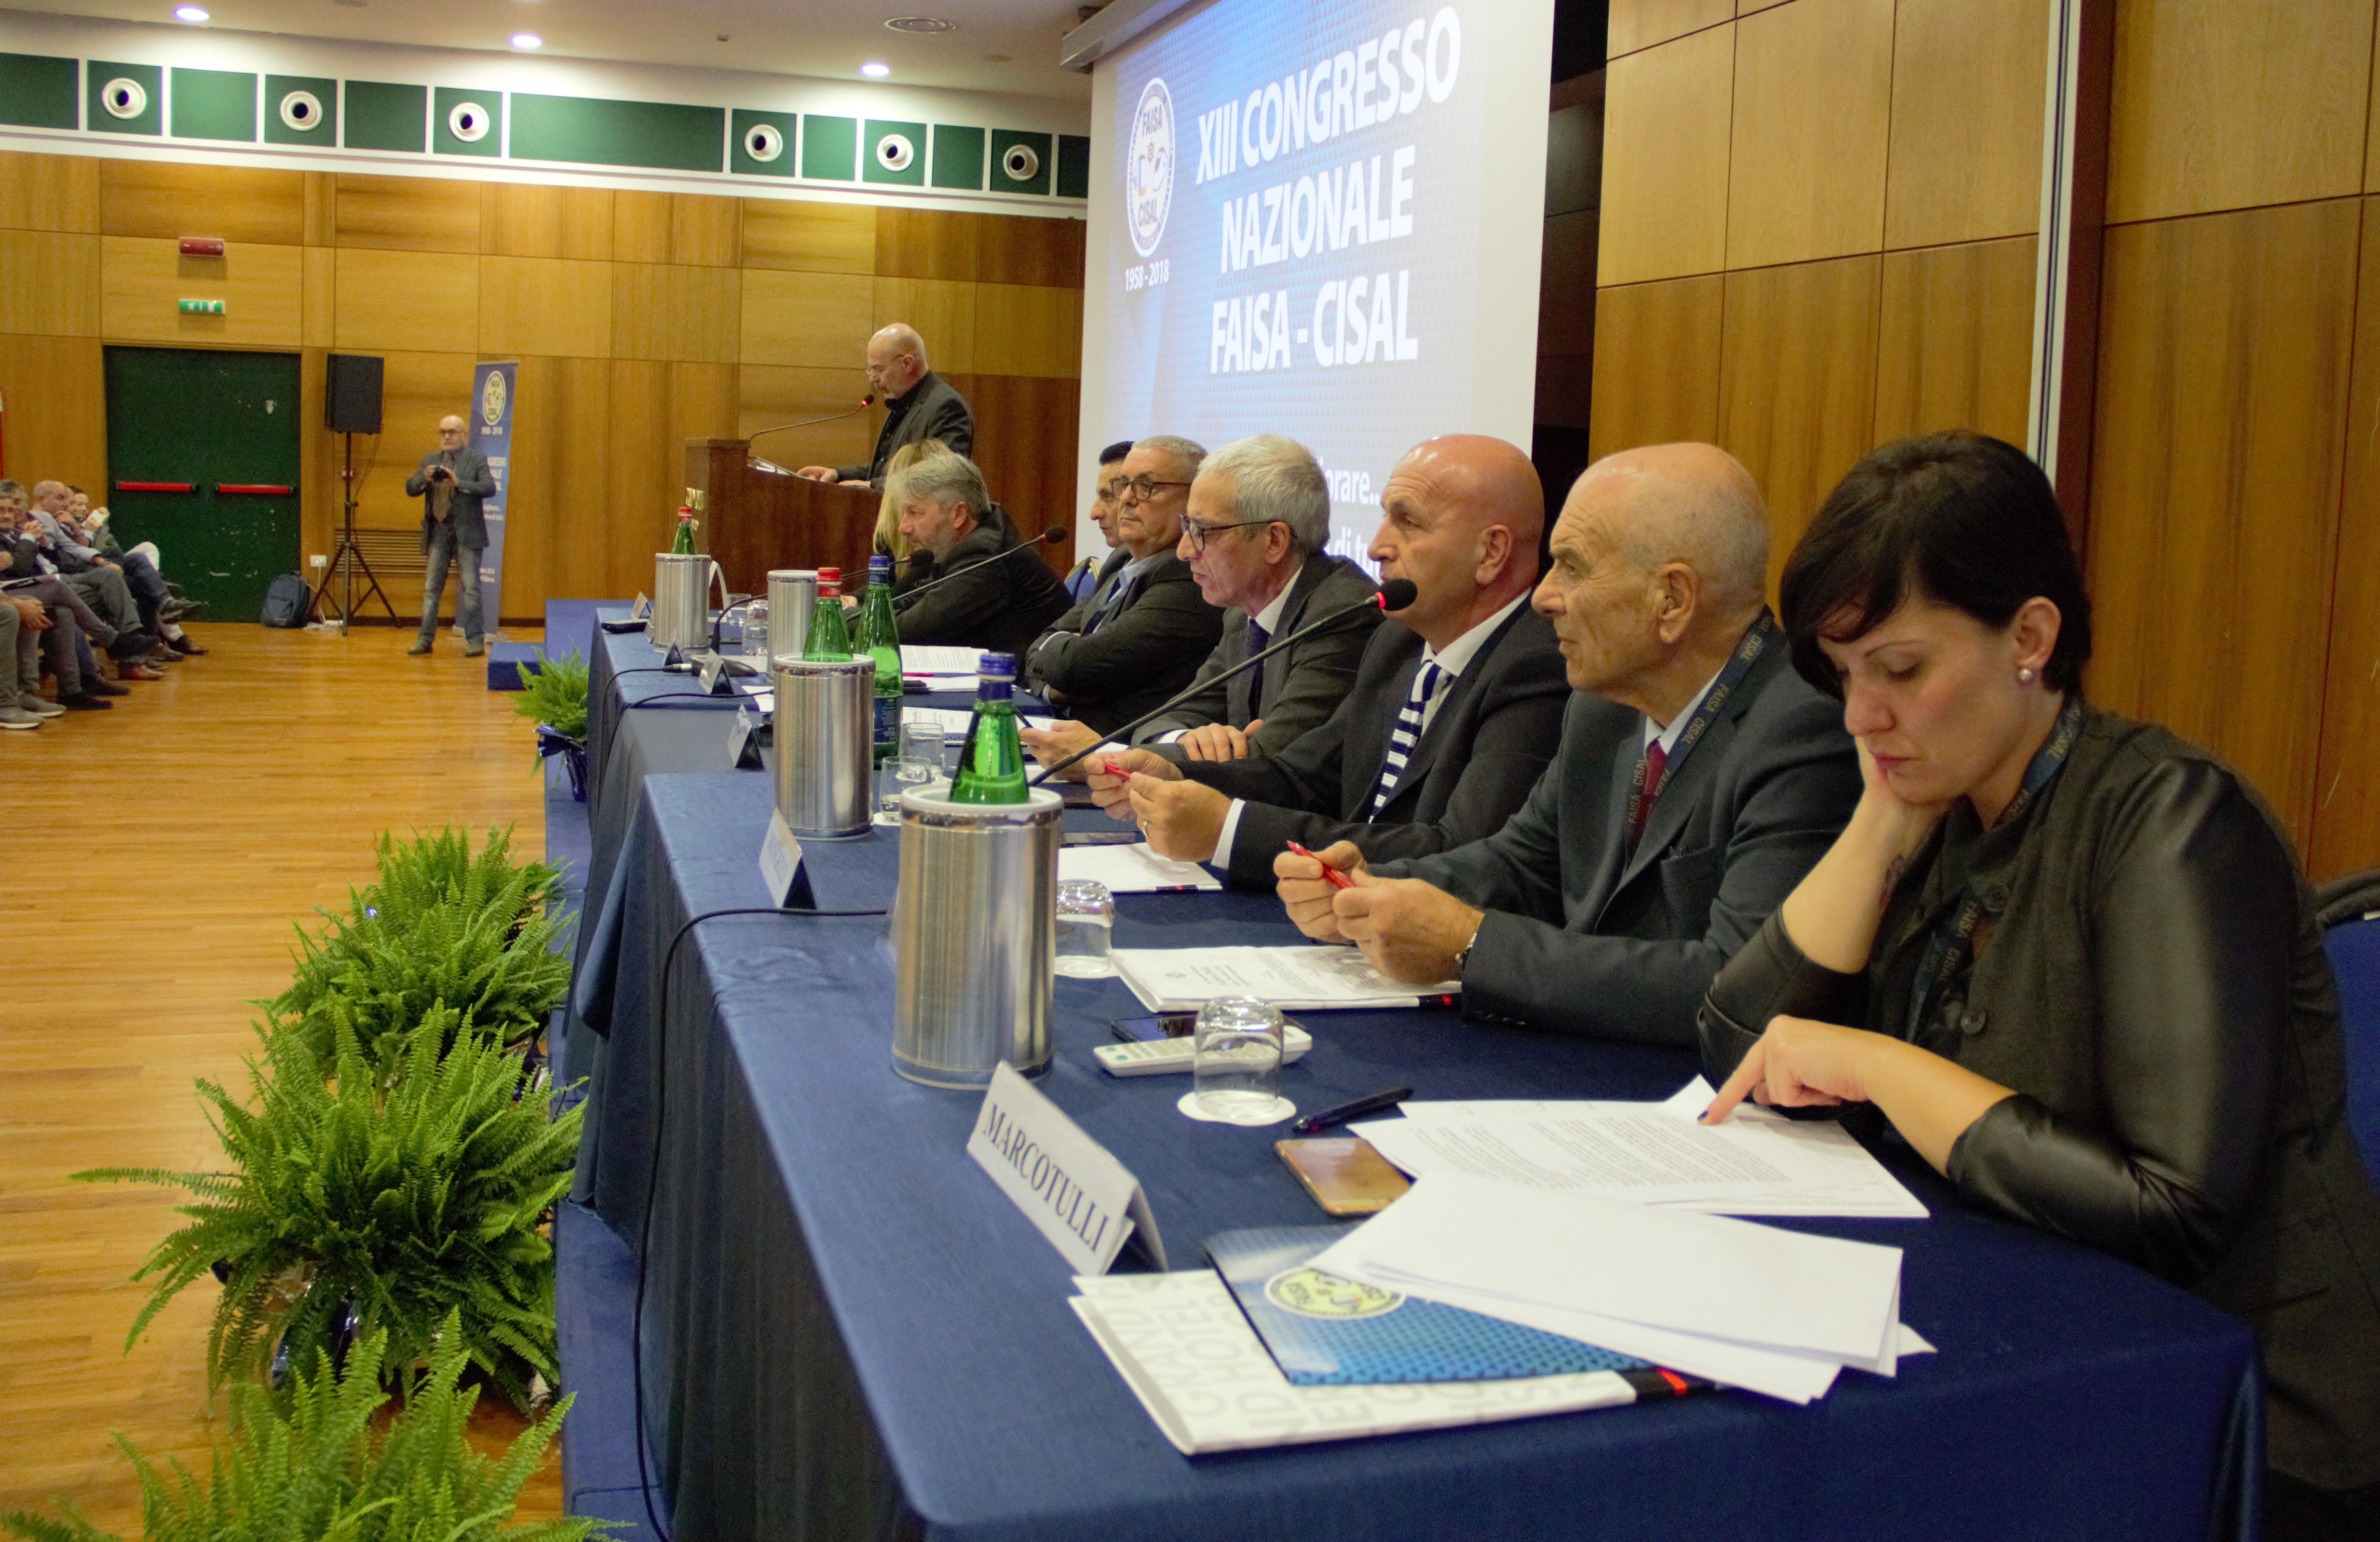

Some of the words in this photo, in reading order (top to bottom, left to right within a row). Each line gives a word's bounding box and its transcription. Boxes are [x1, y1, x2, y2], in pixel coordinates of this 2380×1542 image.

[1196, 100, 1239, 185] XIII
[1242, 6, 1461, 168] CONGRESSO
[1142, 104, 1162, 137] FAISA
[1138, 202, 1158, 227] CISAL
[1221, 145, 1415, 274] NAZIONALE
[1126, 265, 1144, 292] 1958
[1149, 259, 1170, 287] 2018
[1210, 290, 1291, 375] FAISA
[1313, 270, 1418, 367] CISAL
[1740, 634, 1762, 660] CISAL
[1705, 683, 1729, 712] FAISA
[1681, 716, 1706, 745] CISAL
[1956, 901, 1979, 938] FAISA
[982, 1103, 1109, 1252] MARCOTULLI
